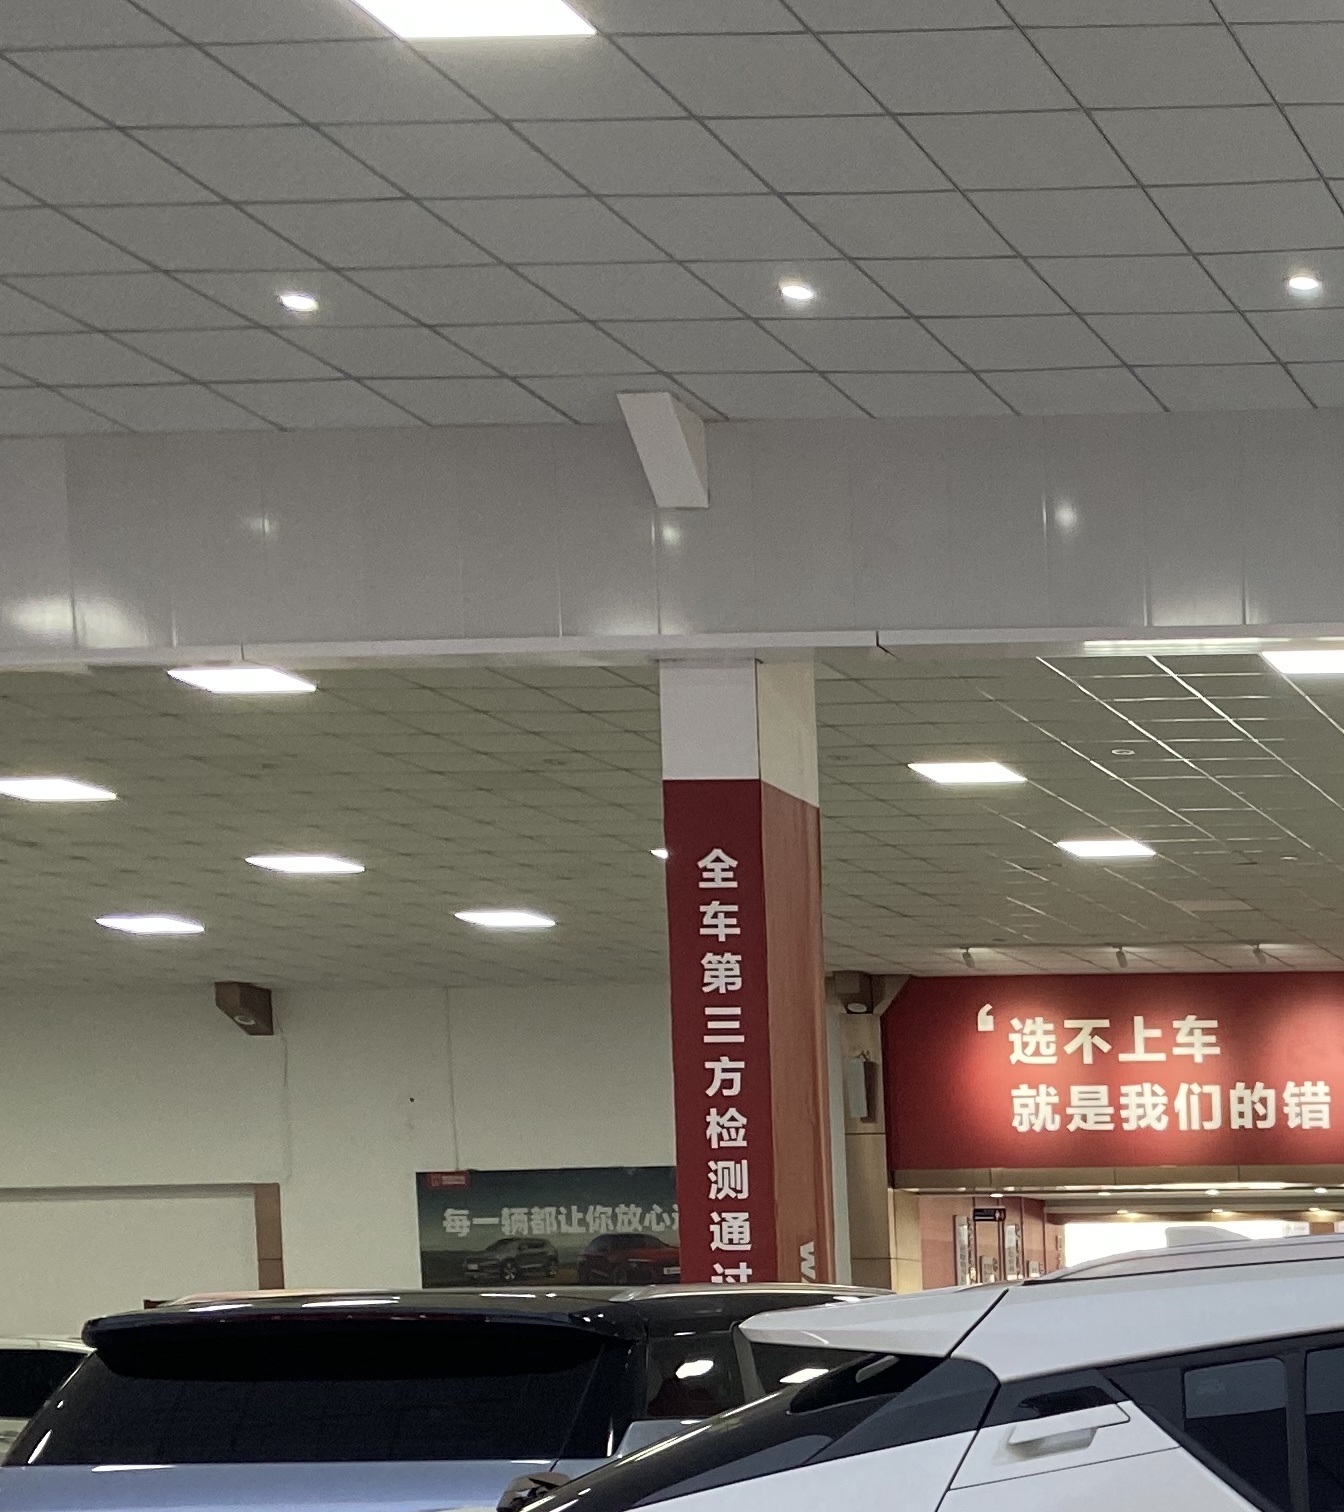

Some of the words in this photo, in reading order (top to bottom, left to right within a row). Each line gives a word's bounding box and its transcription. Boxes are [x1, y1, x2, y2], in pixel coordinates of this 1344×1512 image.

[442, 1203, 678, 1237] 每一辆都让你放心
